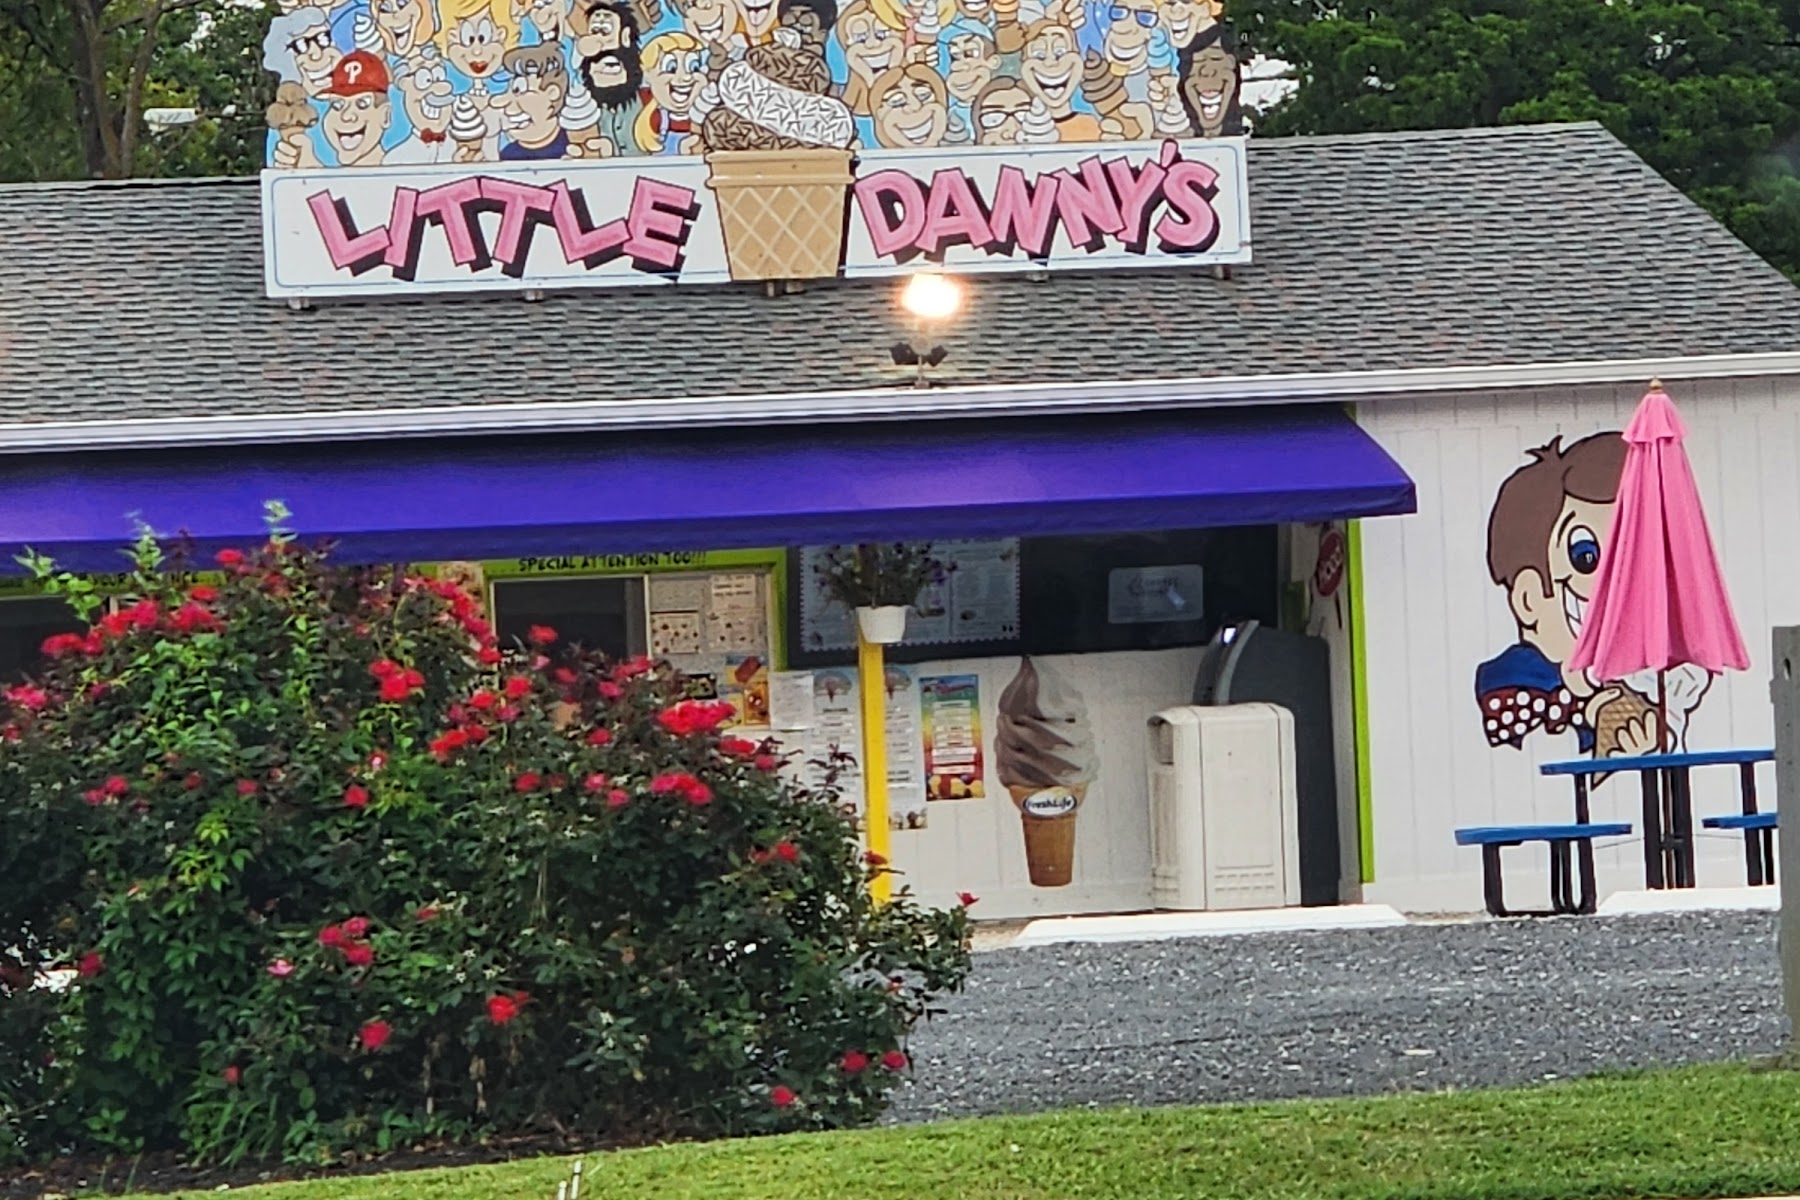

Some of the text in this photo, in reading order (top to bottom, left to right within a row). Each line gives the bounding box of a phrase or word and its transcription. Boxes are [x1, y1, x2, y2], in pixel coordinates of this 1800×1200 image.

[344, 61, 362, 84] P
[306, 138, 1220, 274] LITTLE DANNY'S
[518, 556, 577, 572] SPECIAL
[581, 552, 659, 568] ATTENTION
